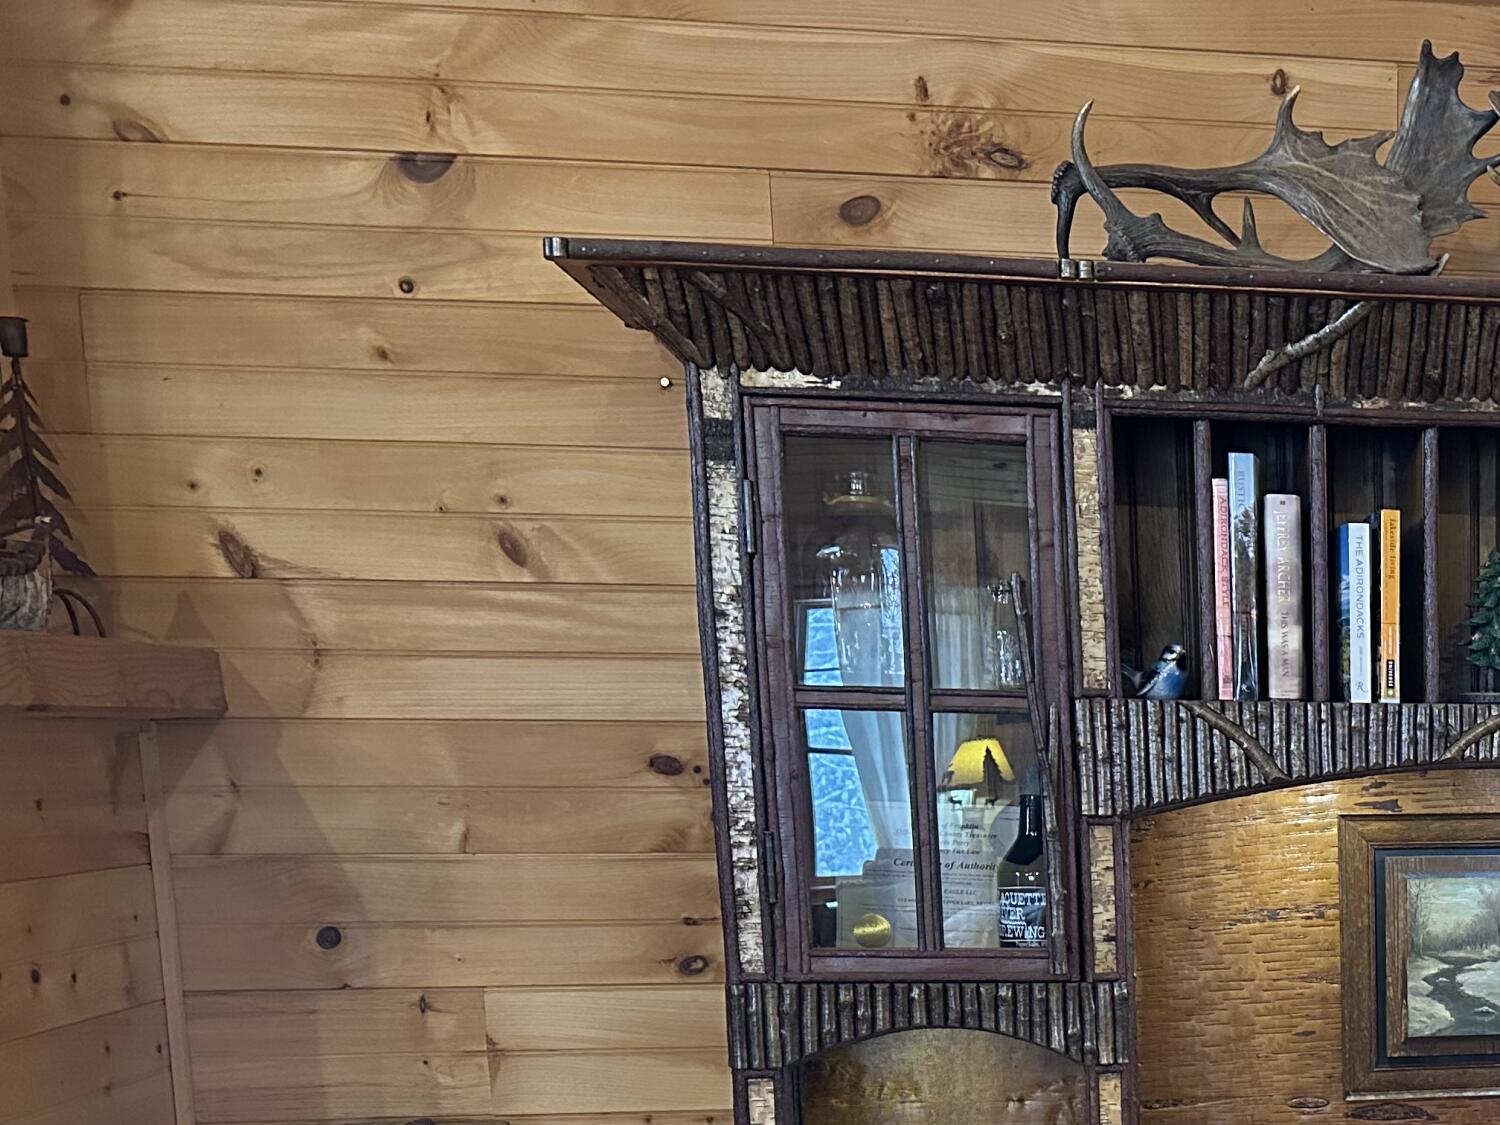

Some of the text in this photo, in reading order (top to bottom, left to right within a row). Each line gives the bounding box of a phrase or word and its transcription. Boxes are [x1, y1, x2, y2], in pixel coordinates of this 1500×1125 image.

[1219, 496, 1229, 572] ADIRONDACK
[1273, 511, 1291, 603] JEFFREY ARCHER
[1355, 536, 1364, 556] THE
[1355, 560, 1365, 639] ADIRONDACKS
[1281, 611, 1289, 678] THIS WAS A MAN
[944, 861, 996, 871] of Authorit
